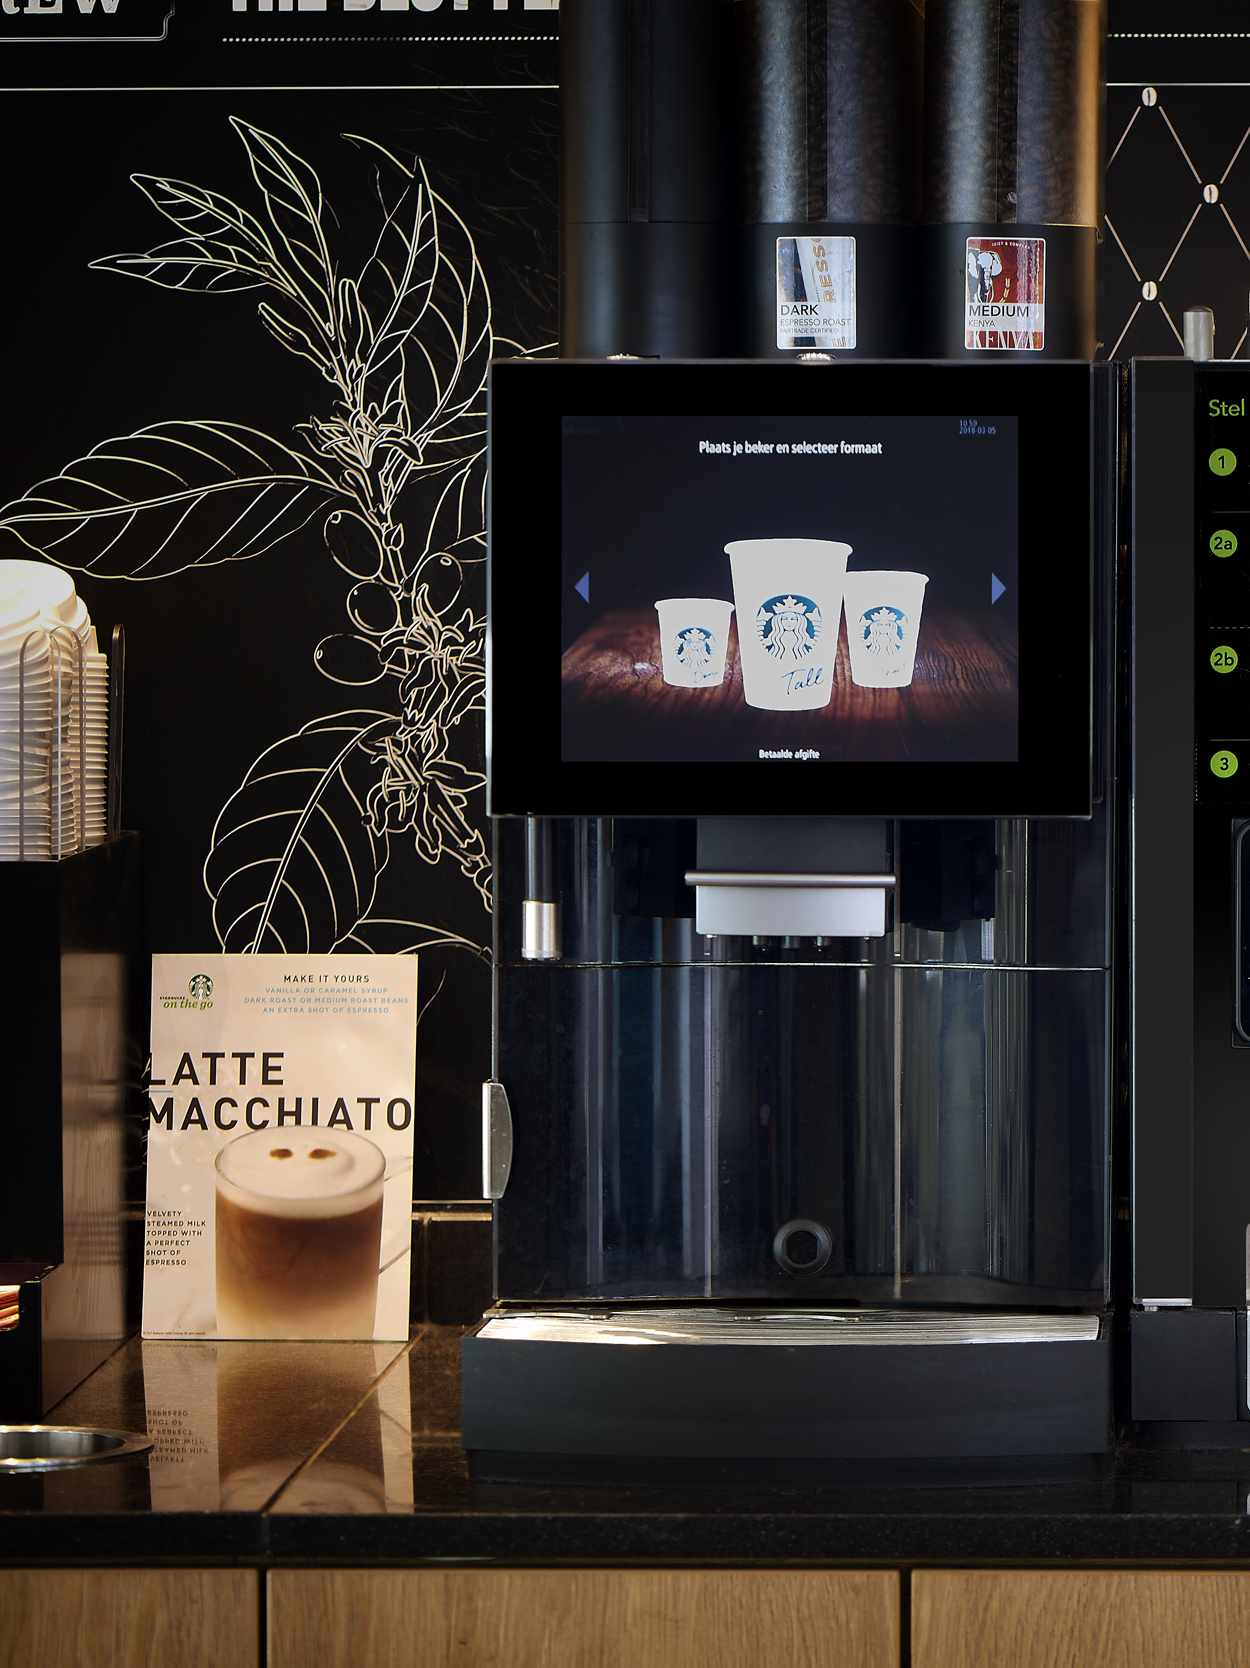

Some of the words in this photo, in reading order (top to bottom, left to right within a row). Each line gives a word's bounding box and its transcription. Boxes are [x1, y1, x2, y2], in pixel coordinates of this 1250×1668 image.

[780, 304, 819, 316] DARK
[968, 305, 1030, 317] MEDIUM
[780, 318, 821, 327] ESPRESSO
[823, 318, 851, 327] ROAST
[968, 320, 996, 328] KENYA
[1209, 398, 1245, 417] Stel
[699, 441, 731, 455] Plaats
[732, 441, 743, 456] je
[745, 441, 774, 455] beker
[776, 443, 789, 455] en
[791, 441, 838, 455] selecteer
[839, 441, 883, 455] formaat
[1218, 455, 1224, 469] 1
[1214, 536, 1232, 550] 2a
[1214, 652, 1234, 666] 2b
[782, 668, 824, 695] Tall
[758, 749, 793, 759] Betaalde
[794, 749, 820, 760] afgifte
[1220, 757, 1229, 771] 3
[283, 974, 314, 983] MAKE
[318, 974, 329, 983] IT
[333, 974, 370, 983] YOURS
[163, 1000, 178, 1009] on
[179, 999, 198, 1009] the
[199, 1000, 214, 1011] go
[150, 1052, 284, 1086] LATTE
[149, 1097, 412, 1131] MACCHIATO
